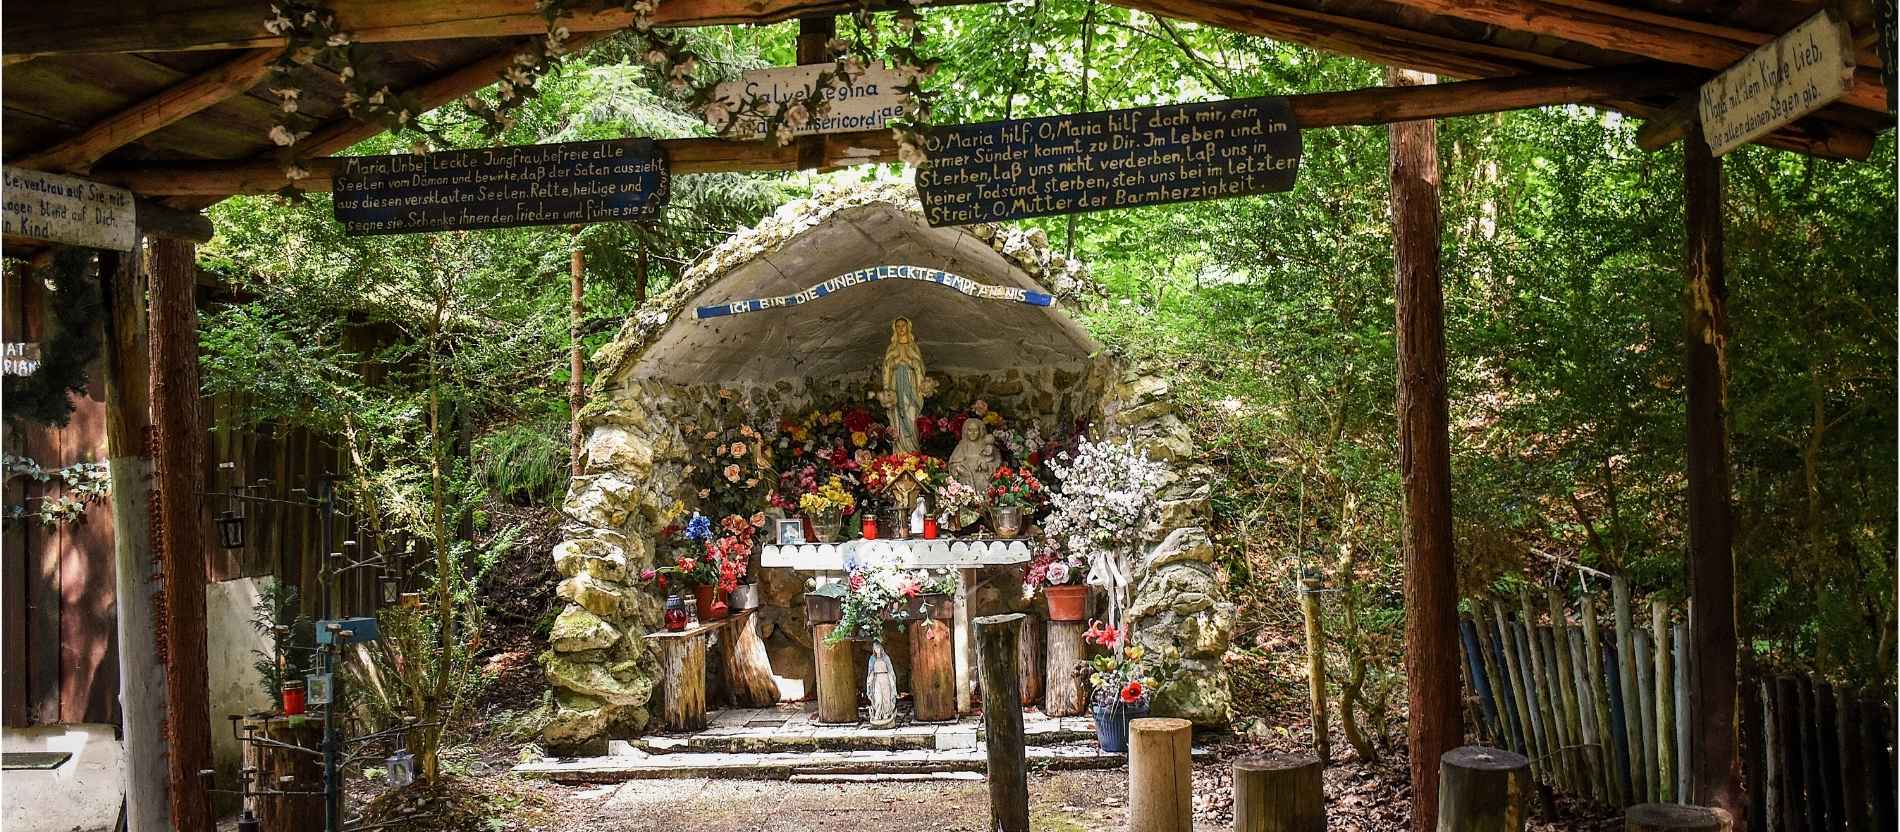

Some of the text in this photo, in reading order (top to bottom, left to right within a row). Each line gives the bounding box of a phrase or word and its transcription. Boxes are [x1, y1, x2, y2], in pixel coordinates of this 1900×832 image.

[812, 84, 879, 101] egina
[1108, 111, 1142, 133] hilf
[1148, 108, 1190, 128] doch
[1230, 104, 1258, 119] ein
[593, 144, 624, 158] alle
[974, 147, 1028, 164] Sünder
[1034, 139, 1084, 157] kommt
[1089, 140, 1107, 152] zu
[1171, 127, 1224, 144] Leben
[1231, 119, 1263, 137] und
[1268, 119, 1288, 133] im
[1029, 164, 1054, 177] uns
[1059, 155, 1094, 173] nicht
[1221, 147, 1247, 158] uns
[1253, 140, 1267, 154] in
[337, 176, 385, 192] Seelen
[388, 179, 410, 189] vom
[452, 170, 472, 184] und
[548, 165, 570, 178] der
[574, 162, 610, 177] Satan
[337, 199, 359, 209] aus
[362, 194, 402, 208] diesen
[620, 175, 643, 193] und
[926, 191, 971, 206] keiner
[1111, 171, 1145, 188] steh
[1150, 170, 1176, 184] uns
[1180, 165, 1201, 180] bei
[1207, 163, 1222, 177] im
[491, 207, 514, 224] den
[516, 201, 559, 222] Frieden
[563, 201, 583, 220] und
[622, 205, 639, 216] sie
[1078, 191, 1107, 208] der
[729, 302, 750, 314] ICH
[760, 298, 786, 309] BIN
[795, 290, 819, 305] DIE
[823, 265, 937, 293] UNBEFLECKTE
